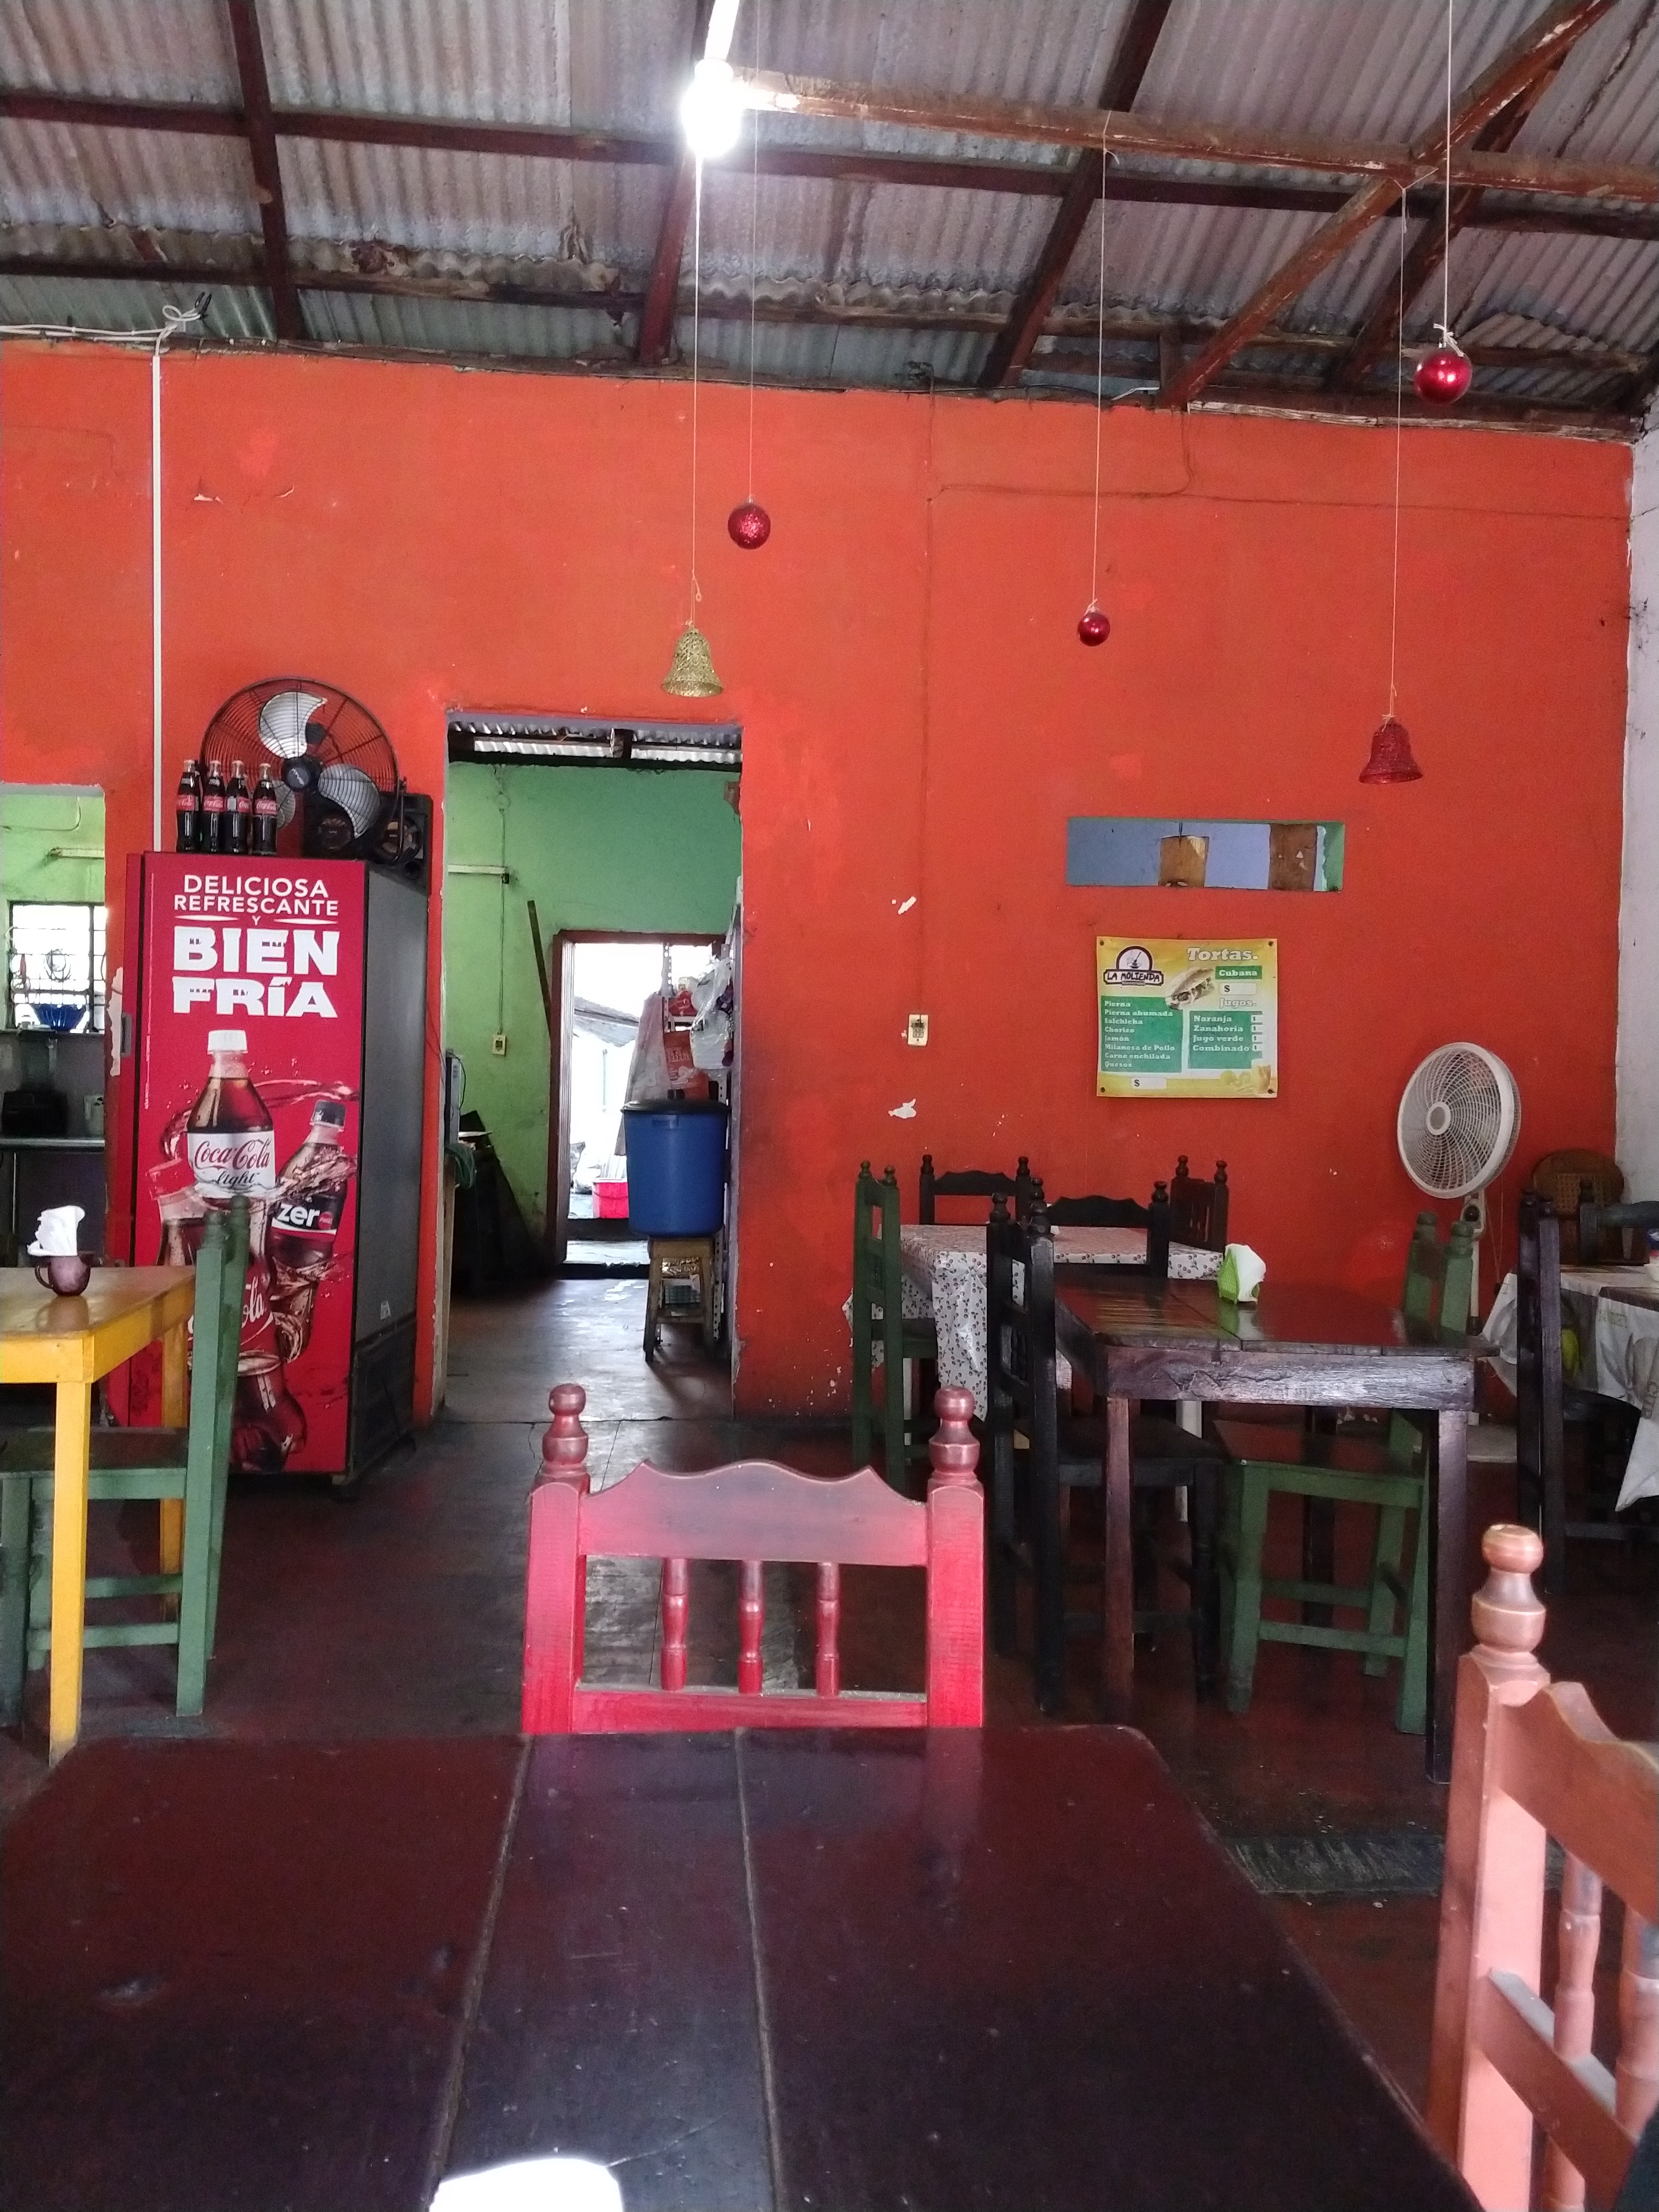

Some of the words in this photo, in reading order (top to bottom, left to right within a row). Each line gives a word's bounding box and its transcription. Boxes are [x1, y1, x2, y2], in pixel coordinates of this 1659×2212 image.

[184, 874, 329, 898] DELICIOSA
[174, 895, 338, 916] REFRESCANTE
[252, 915, 261, 926] Y
[173, 926, 340, 975] BIEN
[1107, 972, 1118, 980] LA
[1120, 972, 1160, 983] MOLIENDA
[172, 976, 338, 1018] FRÍA
[1194, 1015, 1232, 1024] Naranja
[1193, 1035, 1215, 1043] Jugo
[194, 1138, 271, 1170] Coca-Cola
[216, 1171, 256, 1189] light
